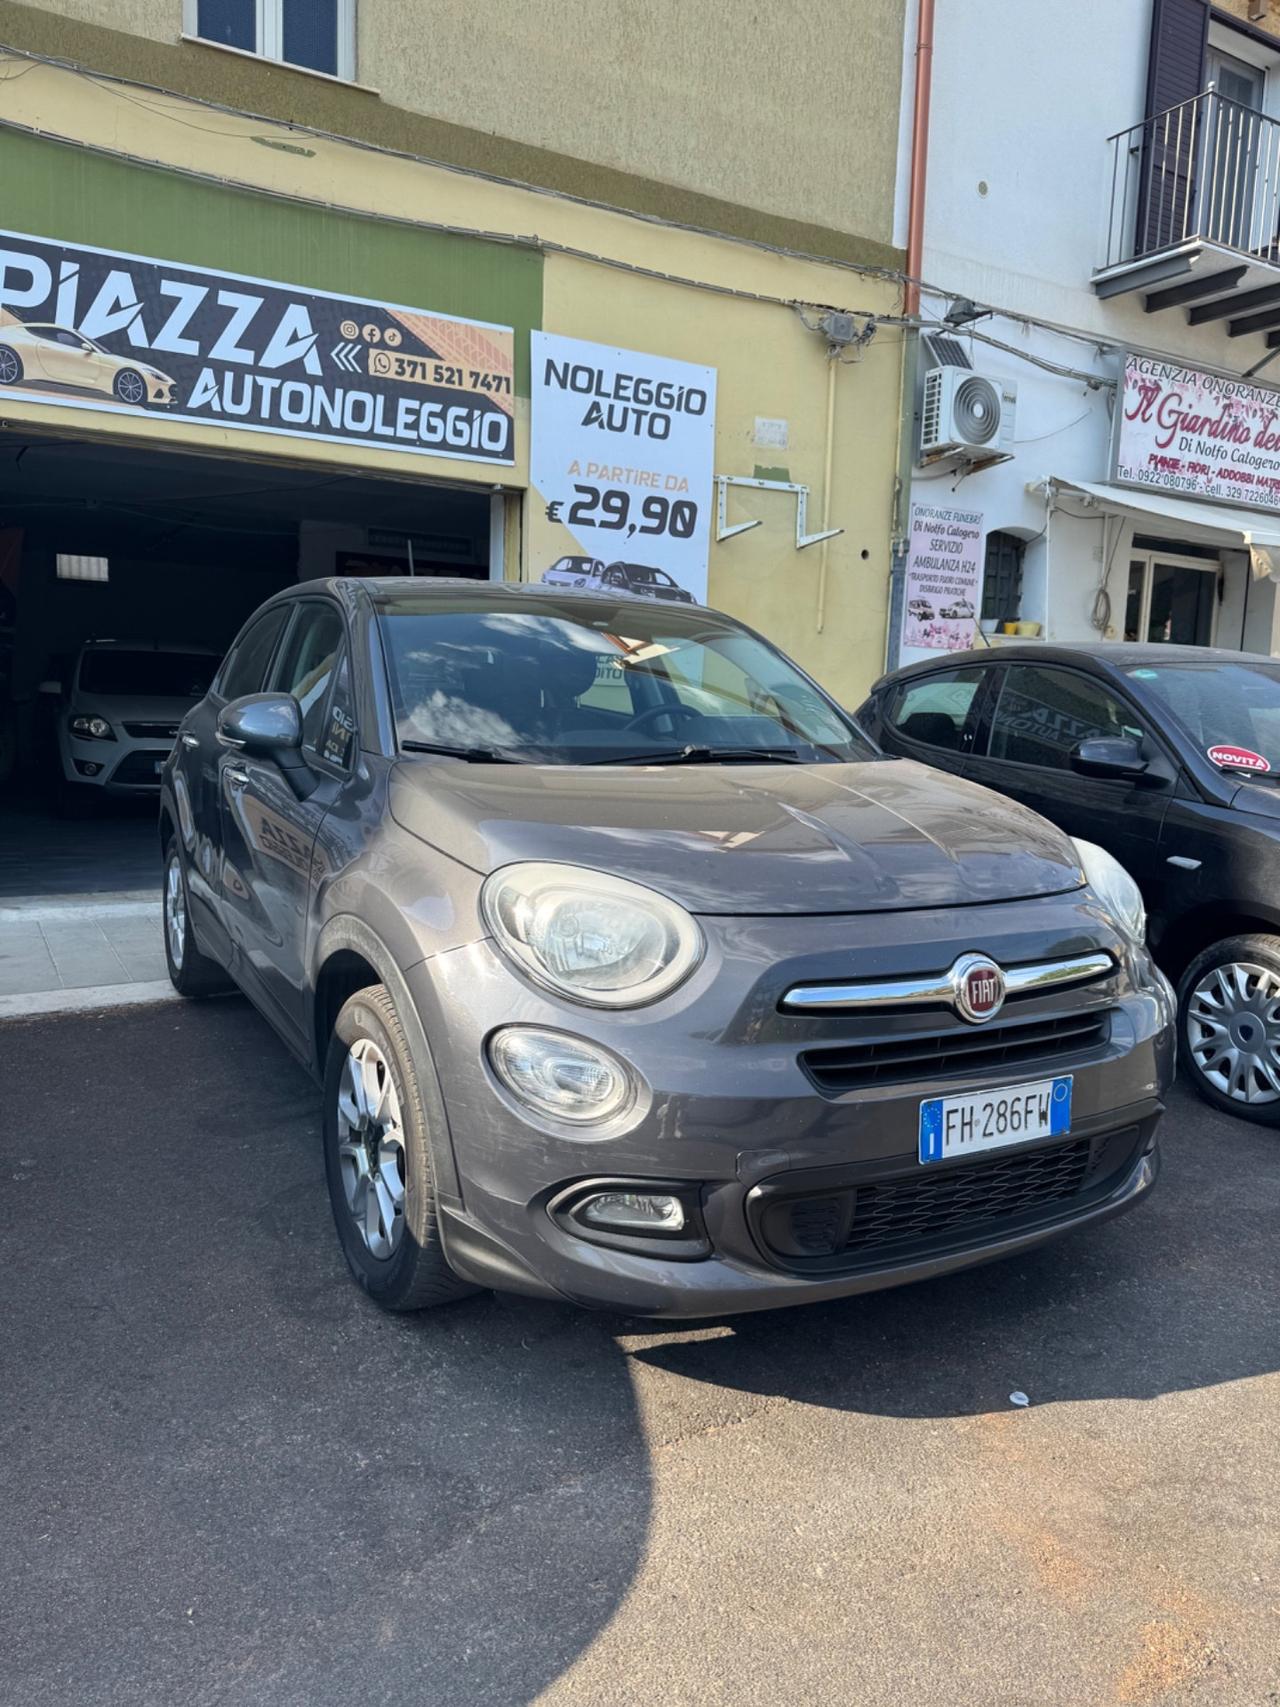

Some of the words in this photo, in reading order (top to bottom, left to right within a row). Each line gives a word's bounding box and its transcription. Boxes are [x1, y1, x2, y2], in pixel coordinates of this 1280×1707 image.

[0, 249, 323, 376] PIAZZA
[395, 358, 426, 380] 371
[433, 365, 463, 386] 521
[469, 371, 511, 394] 7471
[1127, 357, 1197, 386] AGENZIA
[544, 358, 707, 416] NOLEGGIO
[187, 367, 508, 452] AUTONOLEGGIO
[581, 401, 671, 440] AUTO
[1154, 392, 1251, 449] Giardino
[1178, 437, 1193, 453] Di
[1196, 441, 1228, 460] Nolfo
[1231, 448, 1280, 470] Calogero
[567, 460, 581, 477] A
[587, 462, 661, 489] PARTIRE
[663, 474, 689, 492] DA
[1138, 469, 1160, 484] 0922
[1216, 467, 1255, 484] ADDOBBI
[914, 507, 952, 520] ONORANZE
[913, 520, 923, 532] Di
[947, 525, 980, 539] Calogero
[929, 539, 963, 554] SERVIZIO
[913, 556, 960, 571] AMBULANZA
[961, 560, 976, 573] H24
[971, 978, 995, 1004] FIAT
